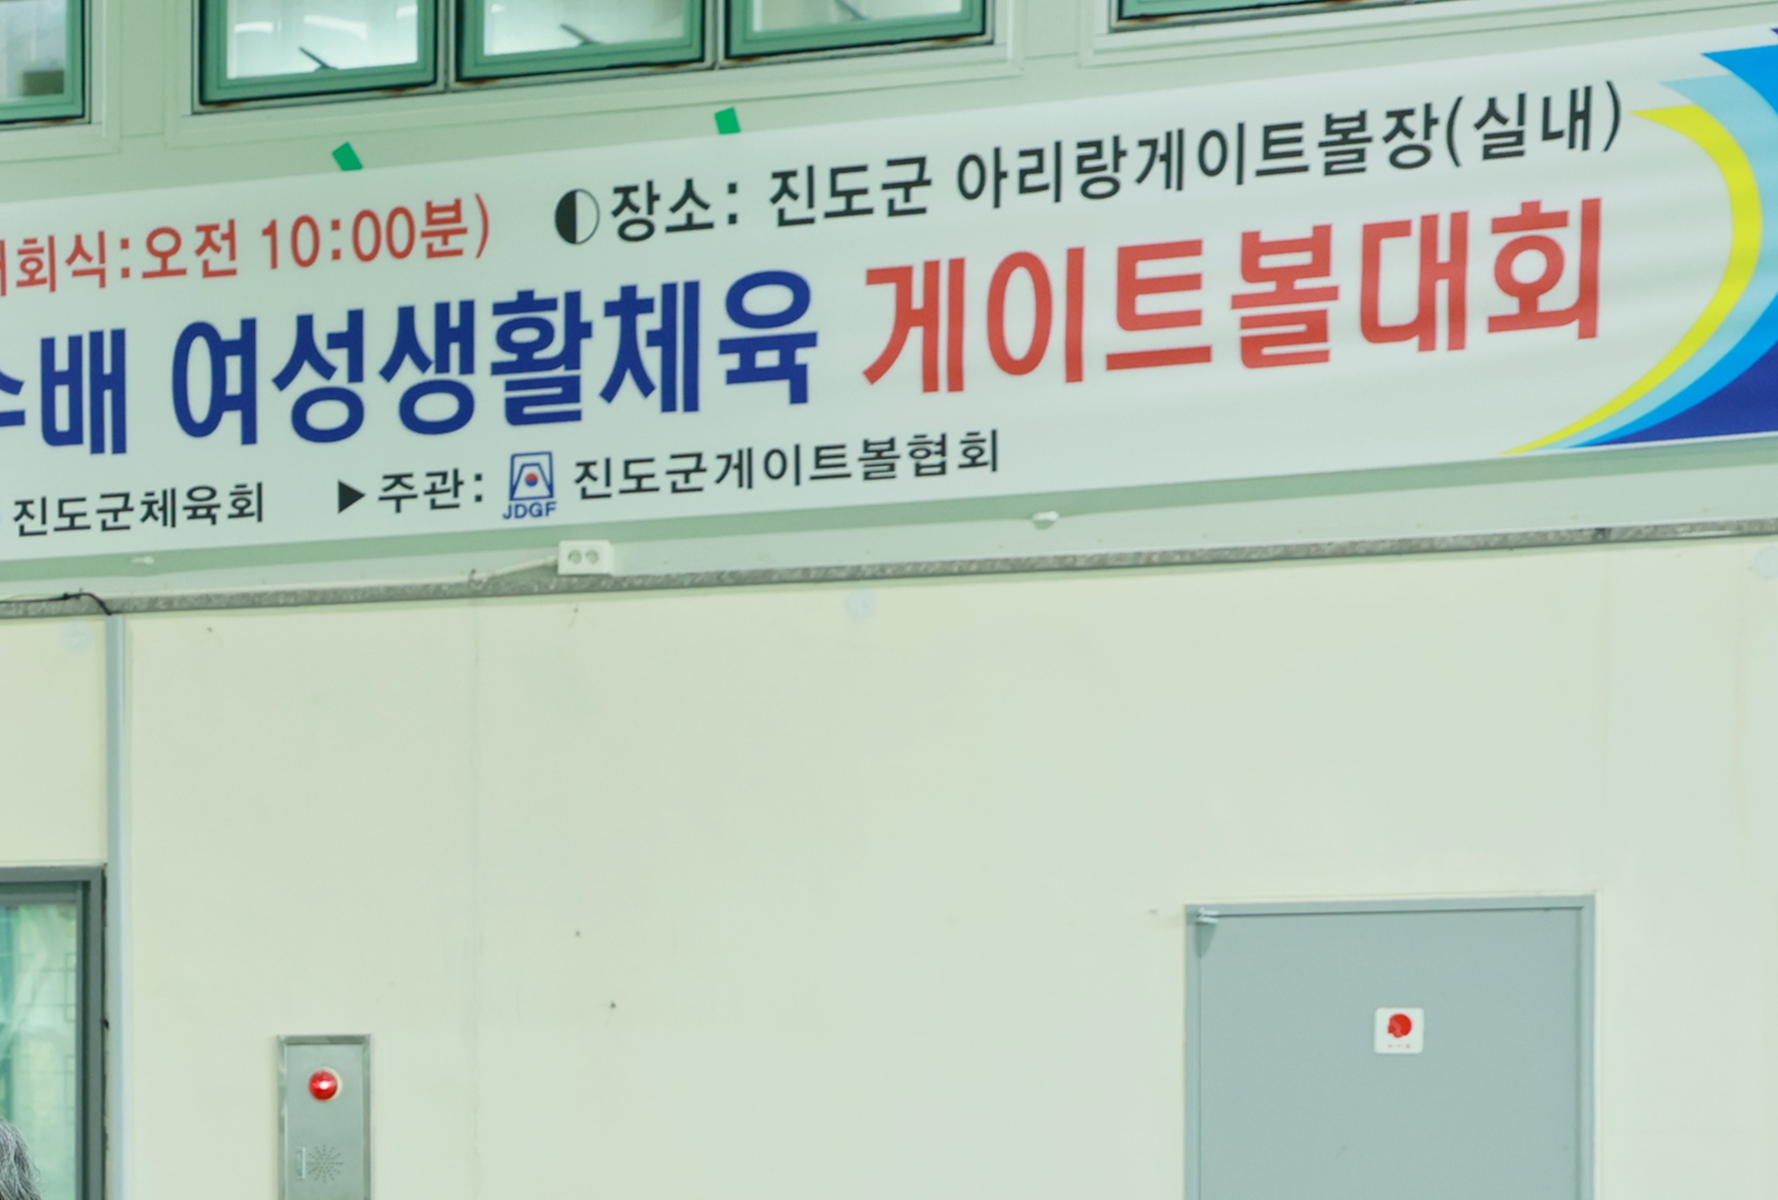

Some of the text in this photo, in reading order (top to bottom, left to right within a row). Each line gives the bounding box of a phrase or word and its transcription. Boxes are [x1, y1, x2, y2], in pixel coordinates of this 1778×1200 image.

[611, 81, 1620, 242] 장소: 진도군 아리랑게이트볼장(실내)
[262, 194, 489, 269] 10:00분)
[171, 270, 818, 446] 여성생활체육
[863, 198, 1602, 393] 게이트볼대회
[14, 482, 262, 536] 진도군체육회
[378, 430, 997, 513] 주관: 진도군게이트볼협회
[503, 501, 556, 520] JDGF
